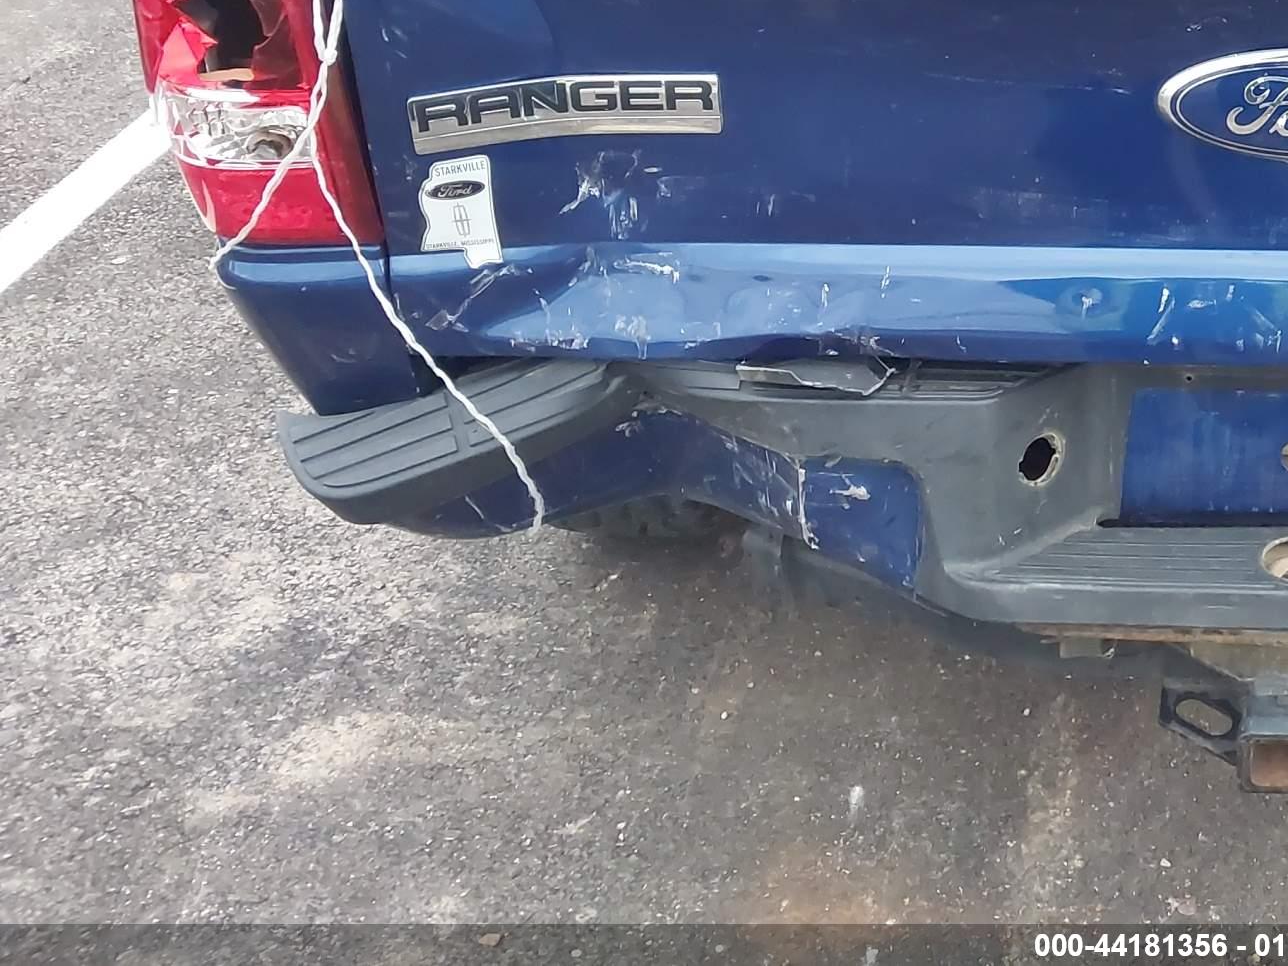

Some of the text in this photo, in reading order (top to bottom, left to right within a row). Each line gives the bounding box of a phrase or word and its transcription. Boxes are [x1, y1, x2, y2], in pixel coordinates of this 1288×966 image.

[412, 80, 714, 133] RANGER
[434, 160, 486, 177] STARKVILLE
[437, 184, 473, 198] Ford
